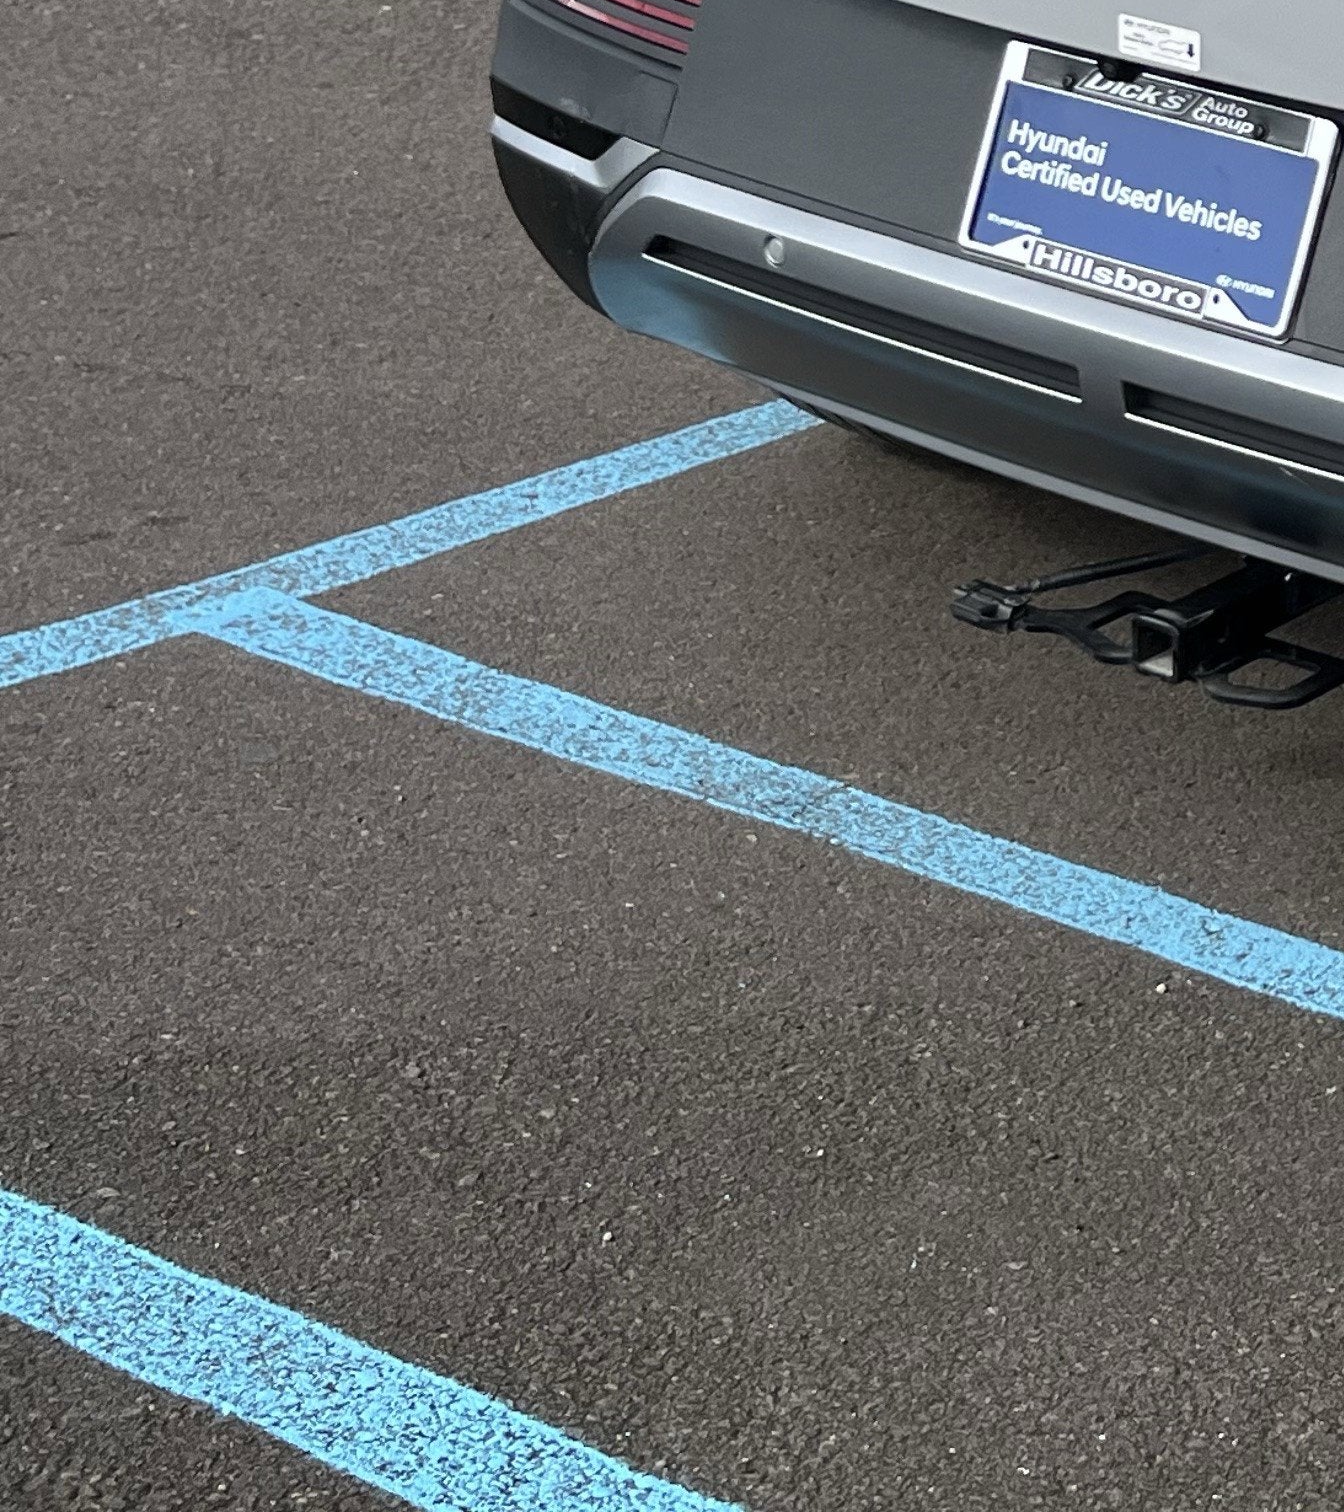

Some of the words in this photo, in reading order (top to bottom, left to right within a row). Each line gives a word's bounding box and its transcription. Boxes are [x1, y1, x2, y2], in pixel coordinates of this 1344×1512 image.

[1192, 107, 1255, 135] Group
[1200, 96, 1249, 119] Auto
[1007, 119, 1109, 166] Hyundai
[1001, 150, 1100, 197] Certified
[1101, 176, 1163, 214] Used
[1165, 192, 1263, 241] Vehicles
[1033, 243, 1202, 310] Hillsboro
